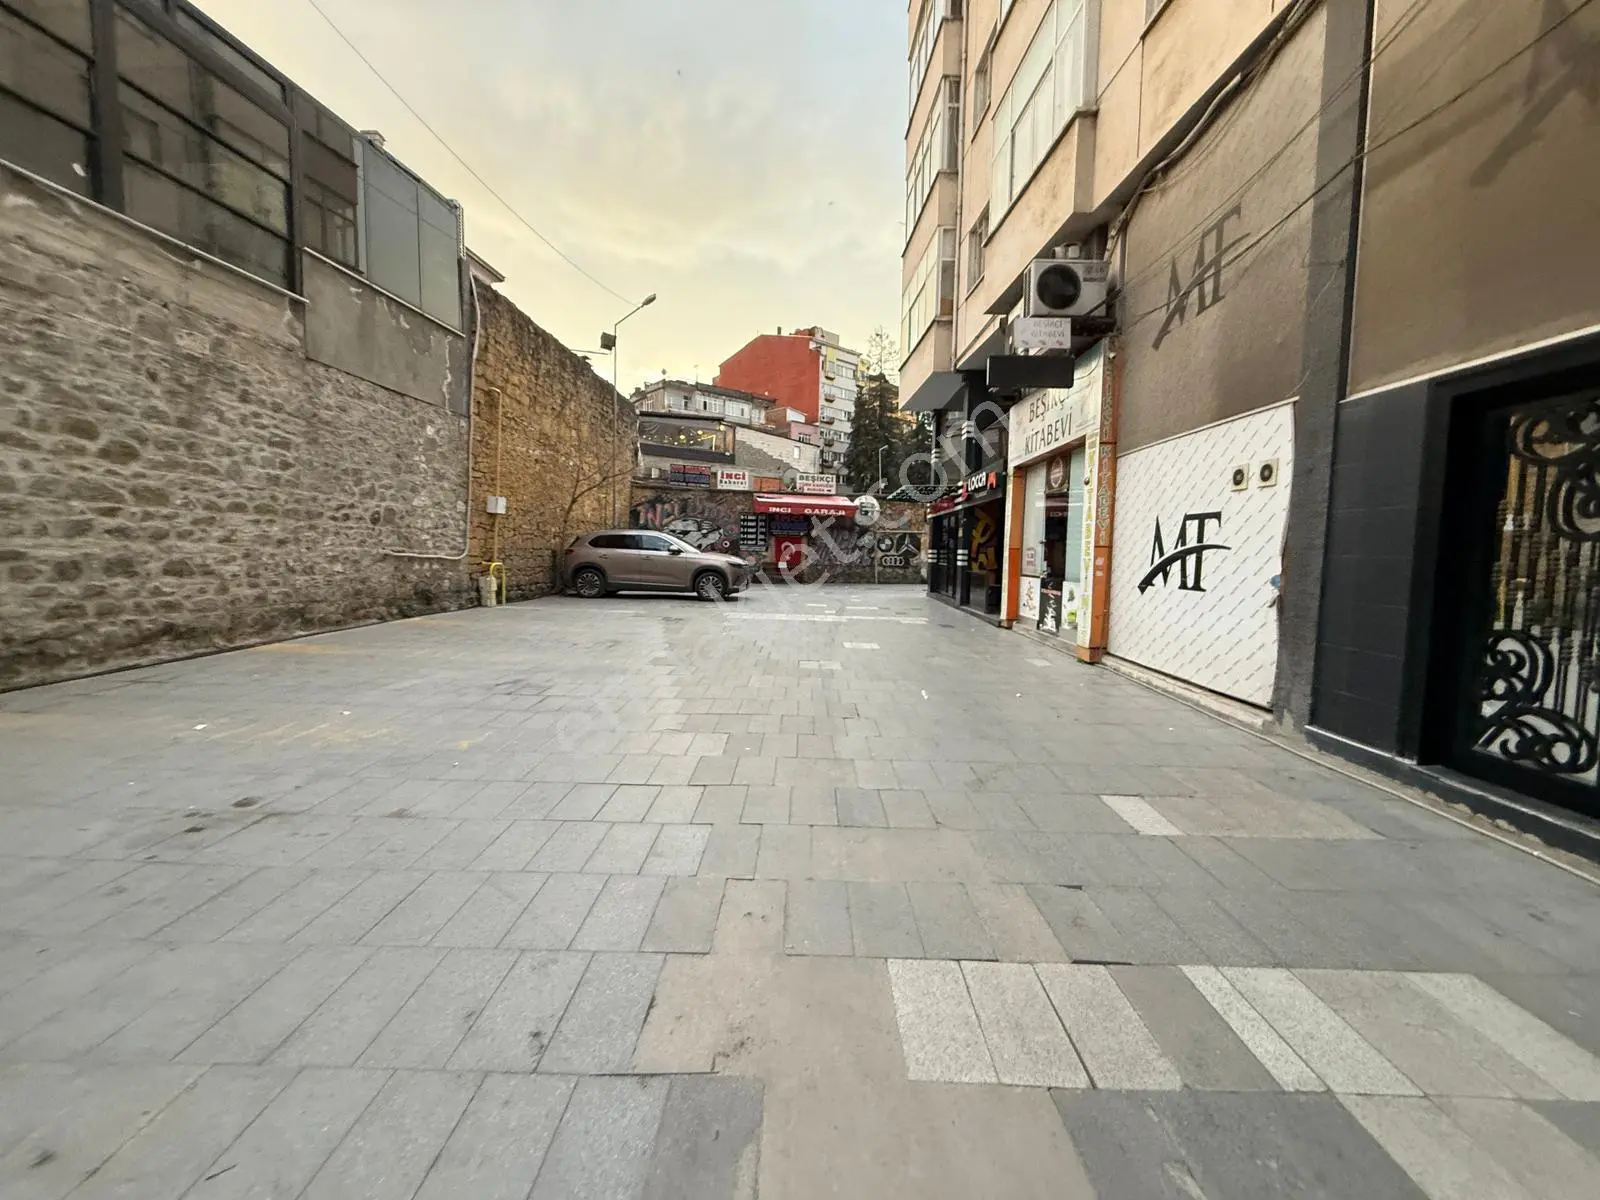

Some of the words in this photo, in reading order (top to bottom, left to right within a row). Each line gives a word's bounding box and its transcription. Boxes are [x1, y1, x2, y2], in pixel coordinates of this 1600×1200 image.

[1029, 390, 1070, 423] BEŞİKÇ
[1025, 406, 1073, 455] KİTABEVİ
[967, 471, 987, 492] LOCCA
[1138, 511, 1231, 595] MT
